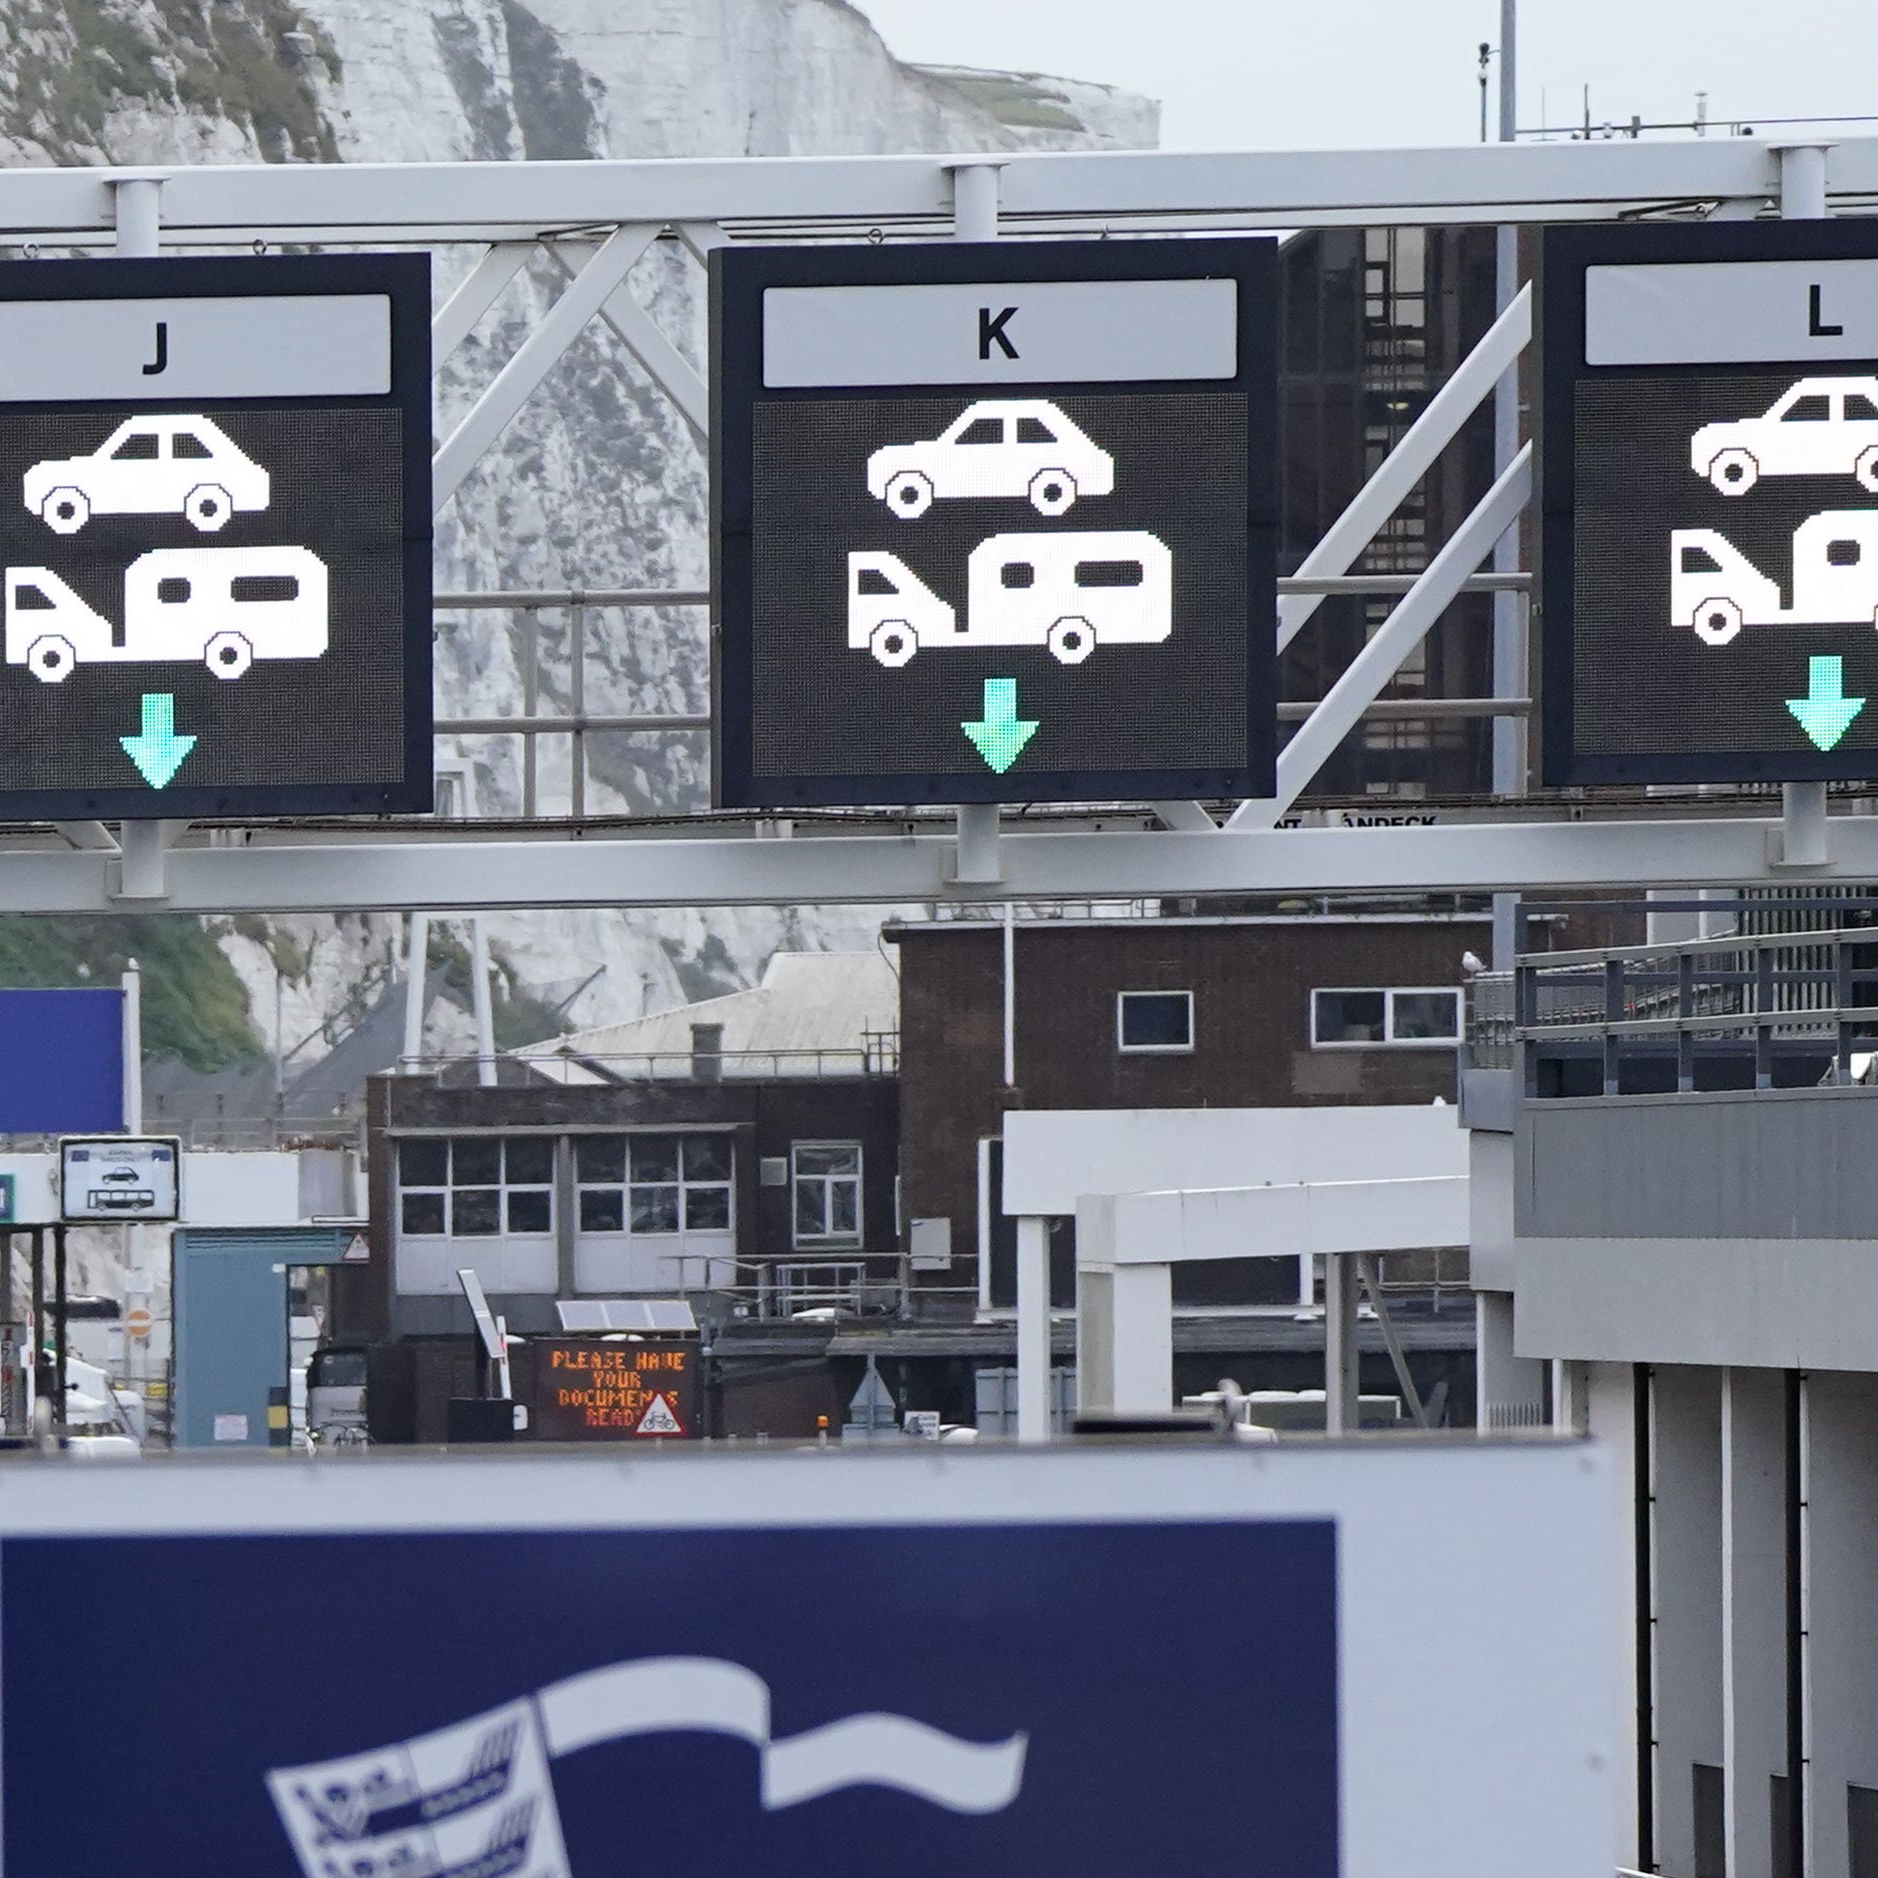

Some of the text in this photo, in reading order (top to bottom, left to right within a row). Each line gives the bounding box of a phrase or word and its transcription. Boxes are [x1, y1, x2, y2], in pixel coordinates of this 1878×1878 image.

[1809, 285, 1843, 336] L
[979, 307, 1019, 359] K
[143, 323, 167, 375] J
[551, 1350, 686, 1371] PLEASE HAVE
[594, 1370, 641, 1388] YOUR
[558, 1389, 678, 1407] DOCUMENS
[585, 1408, 641, 1427] READ
